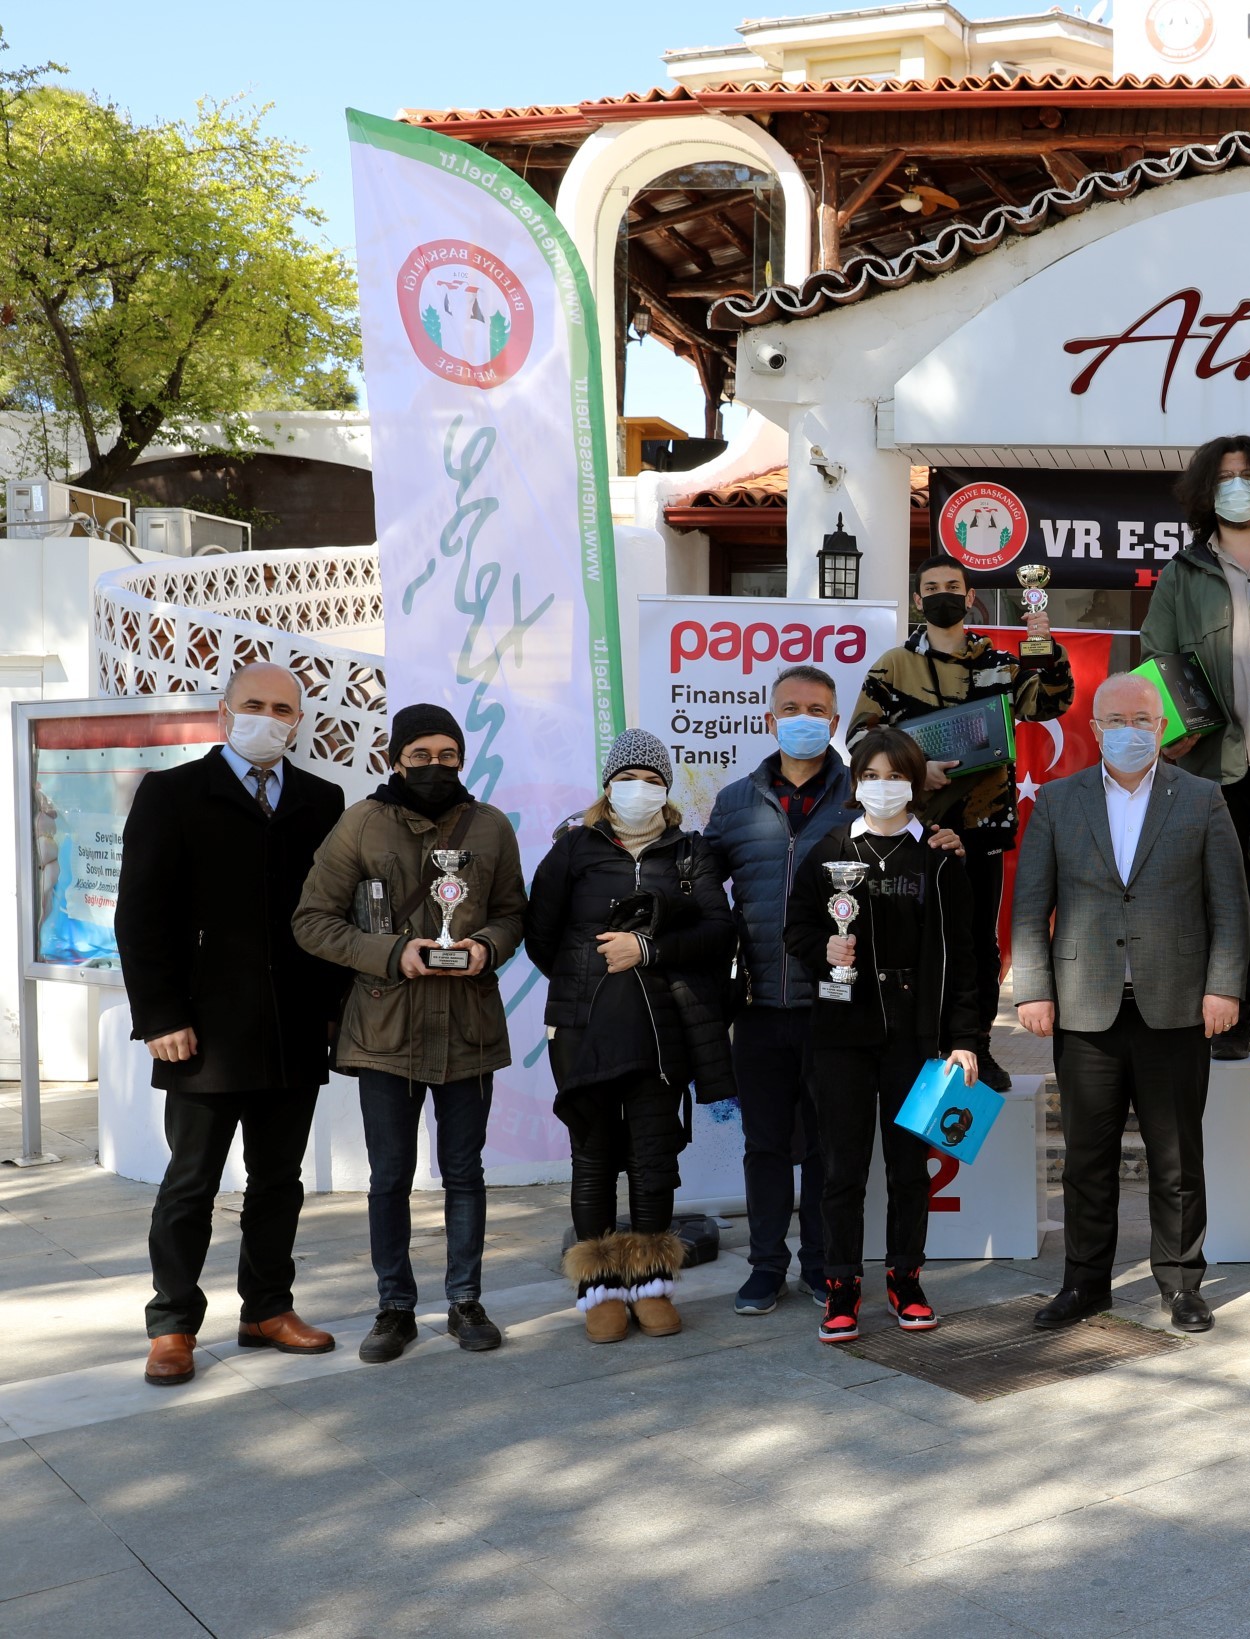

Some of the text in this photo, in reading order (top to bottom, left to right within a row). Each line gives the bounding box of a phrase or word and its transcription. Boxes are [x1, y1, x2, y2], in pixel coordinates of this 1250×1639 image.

[946, 488, 1022, 521] BELEDİYE BAŞKANLIĞI
[1040, 519, 1103, 559] VR
[1117, 521, 1194, 560] E-S
[961, 553, 1004, 565] MENTEŞE
[670, 620, 867, 675] papara
[671, 685, 767, 705] Finansal
[671, 745, 737, 768] Tanış!
